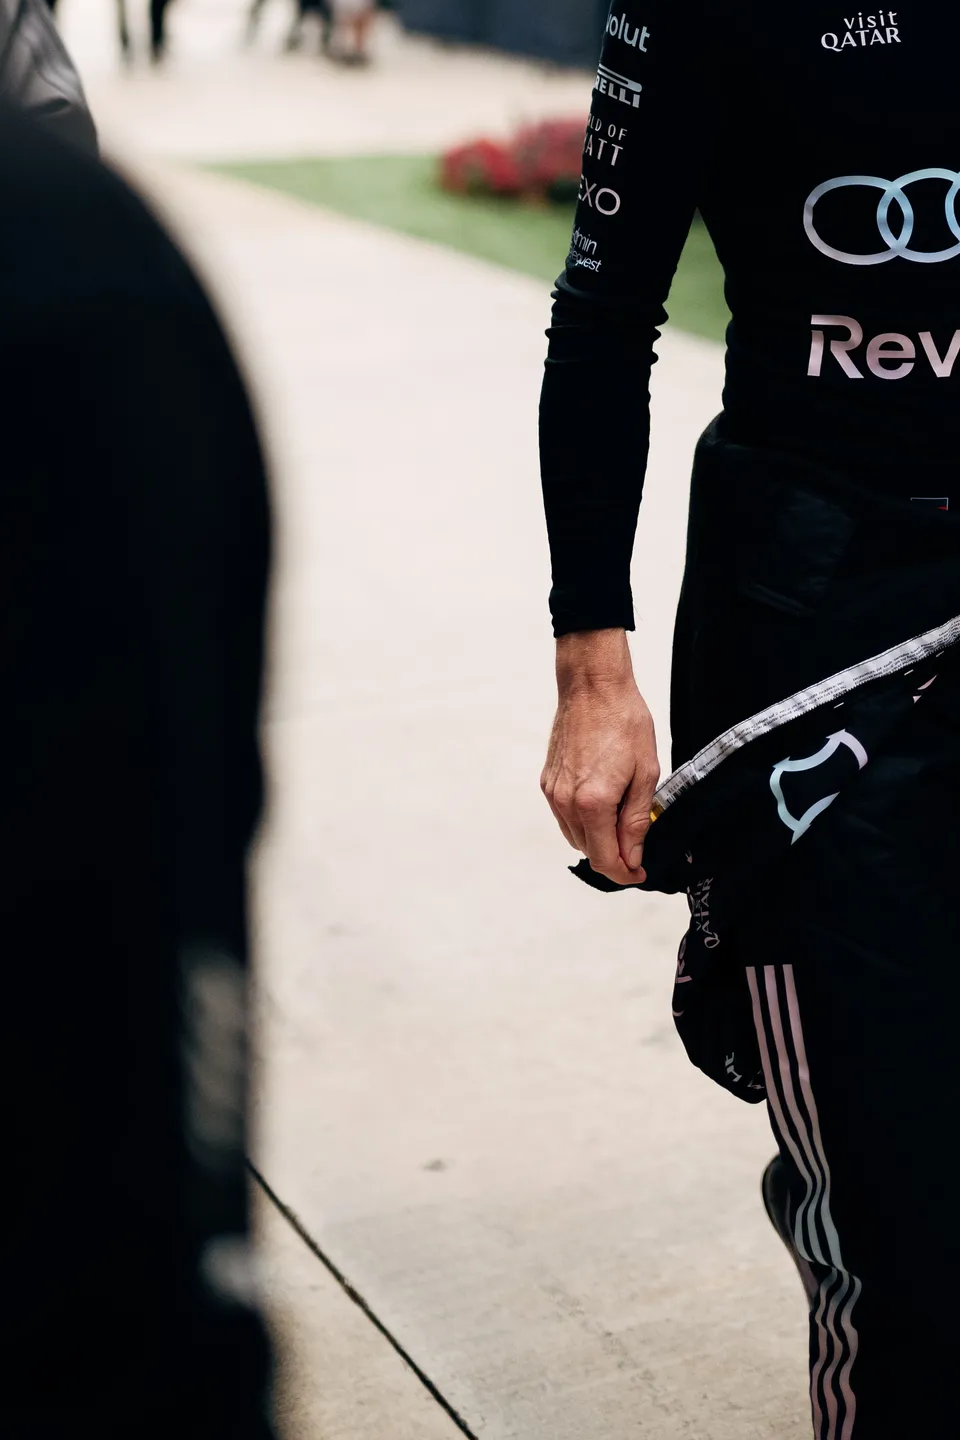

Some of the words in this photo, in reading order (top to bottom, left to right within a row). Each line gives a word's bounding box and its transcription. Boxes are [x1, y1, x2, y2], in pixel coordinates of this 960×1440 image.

[843, 9, 899, 29] visit
[820, 26, 902, 53] QATAR
[607, 123, 629, 142] OF
